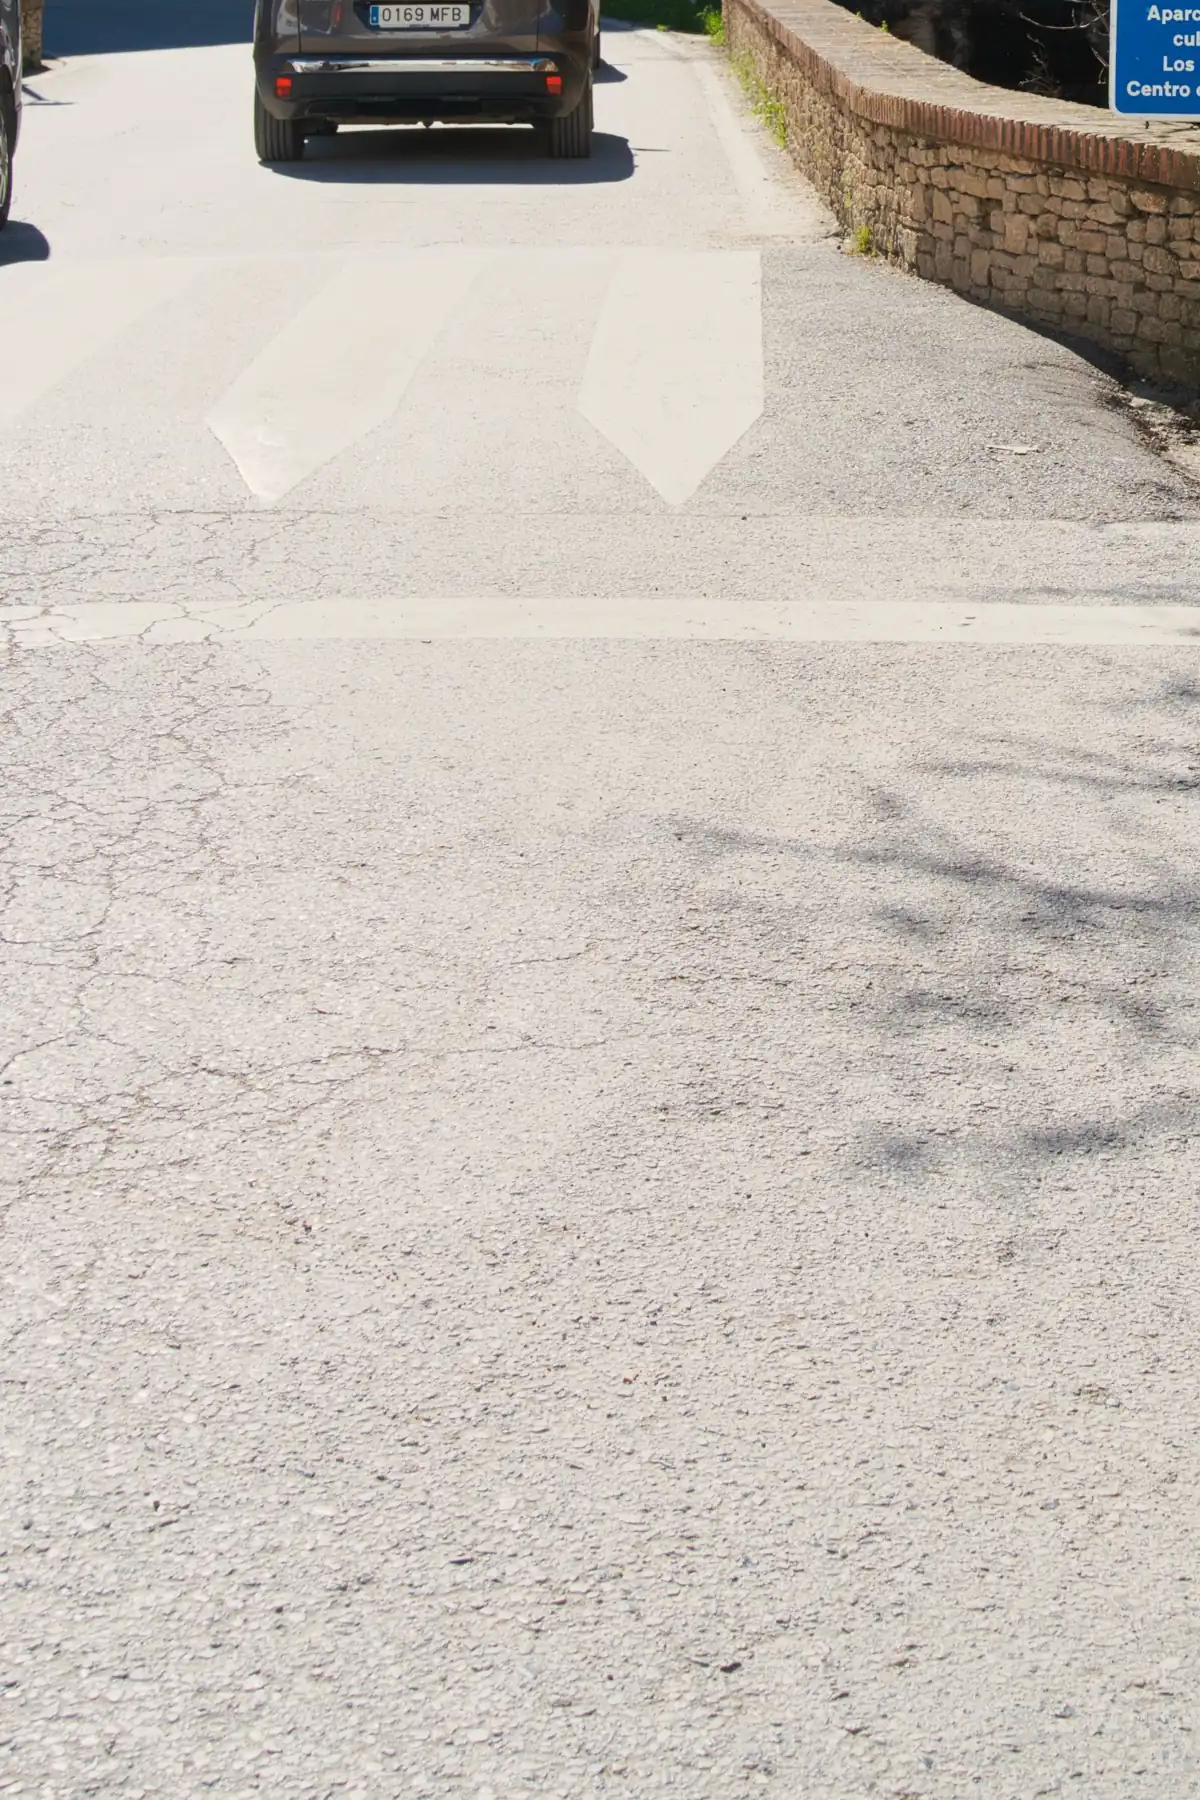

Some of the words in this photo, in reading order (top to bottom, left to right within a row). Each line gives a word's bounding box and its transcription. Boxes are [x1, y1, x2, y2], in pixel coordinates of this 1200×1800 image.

[382, 7, 424, 22] 0169
[430, 7, 462, 22] MFB
[1163, 56, 1195, 72] Los
[1126, 81, 1191, 97] Centro
